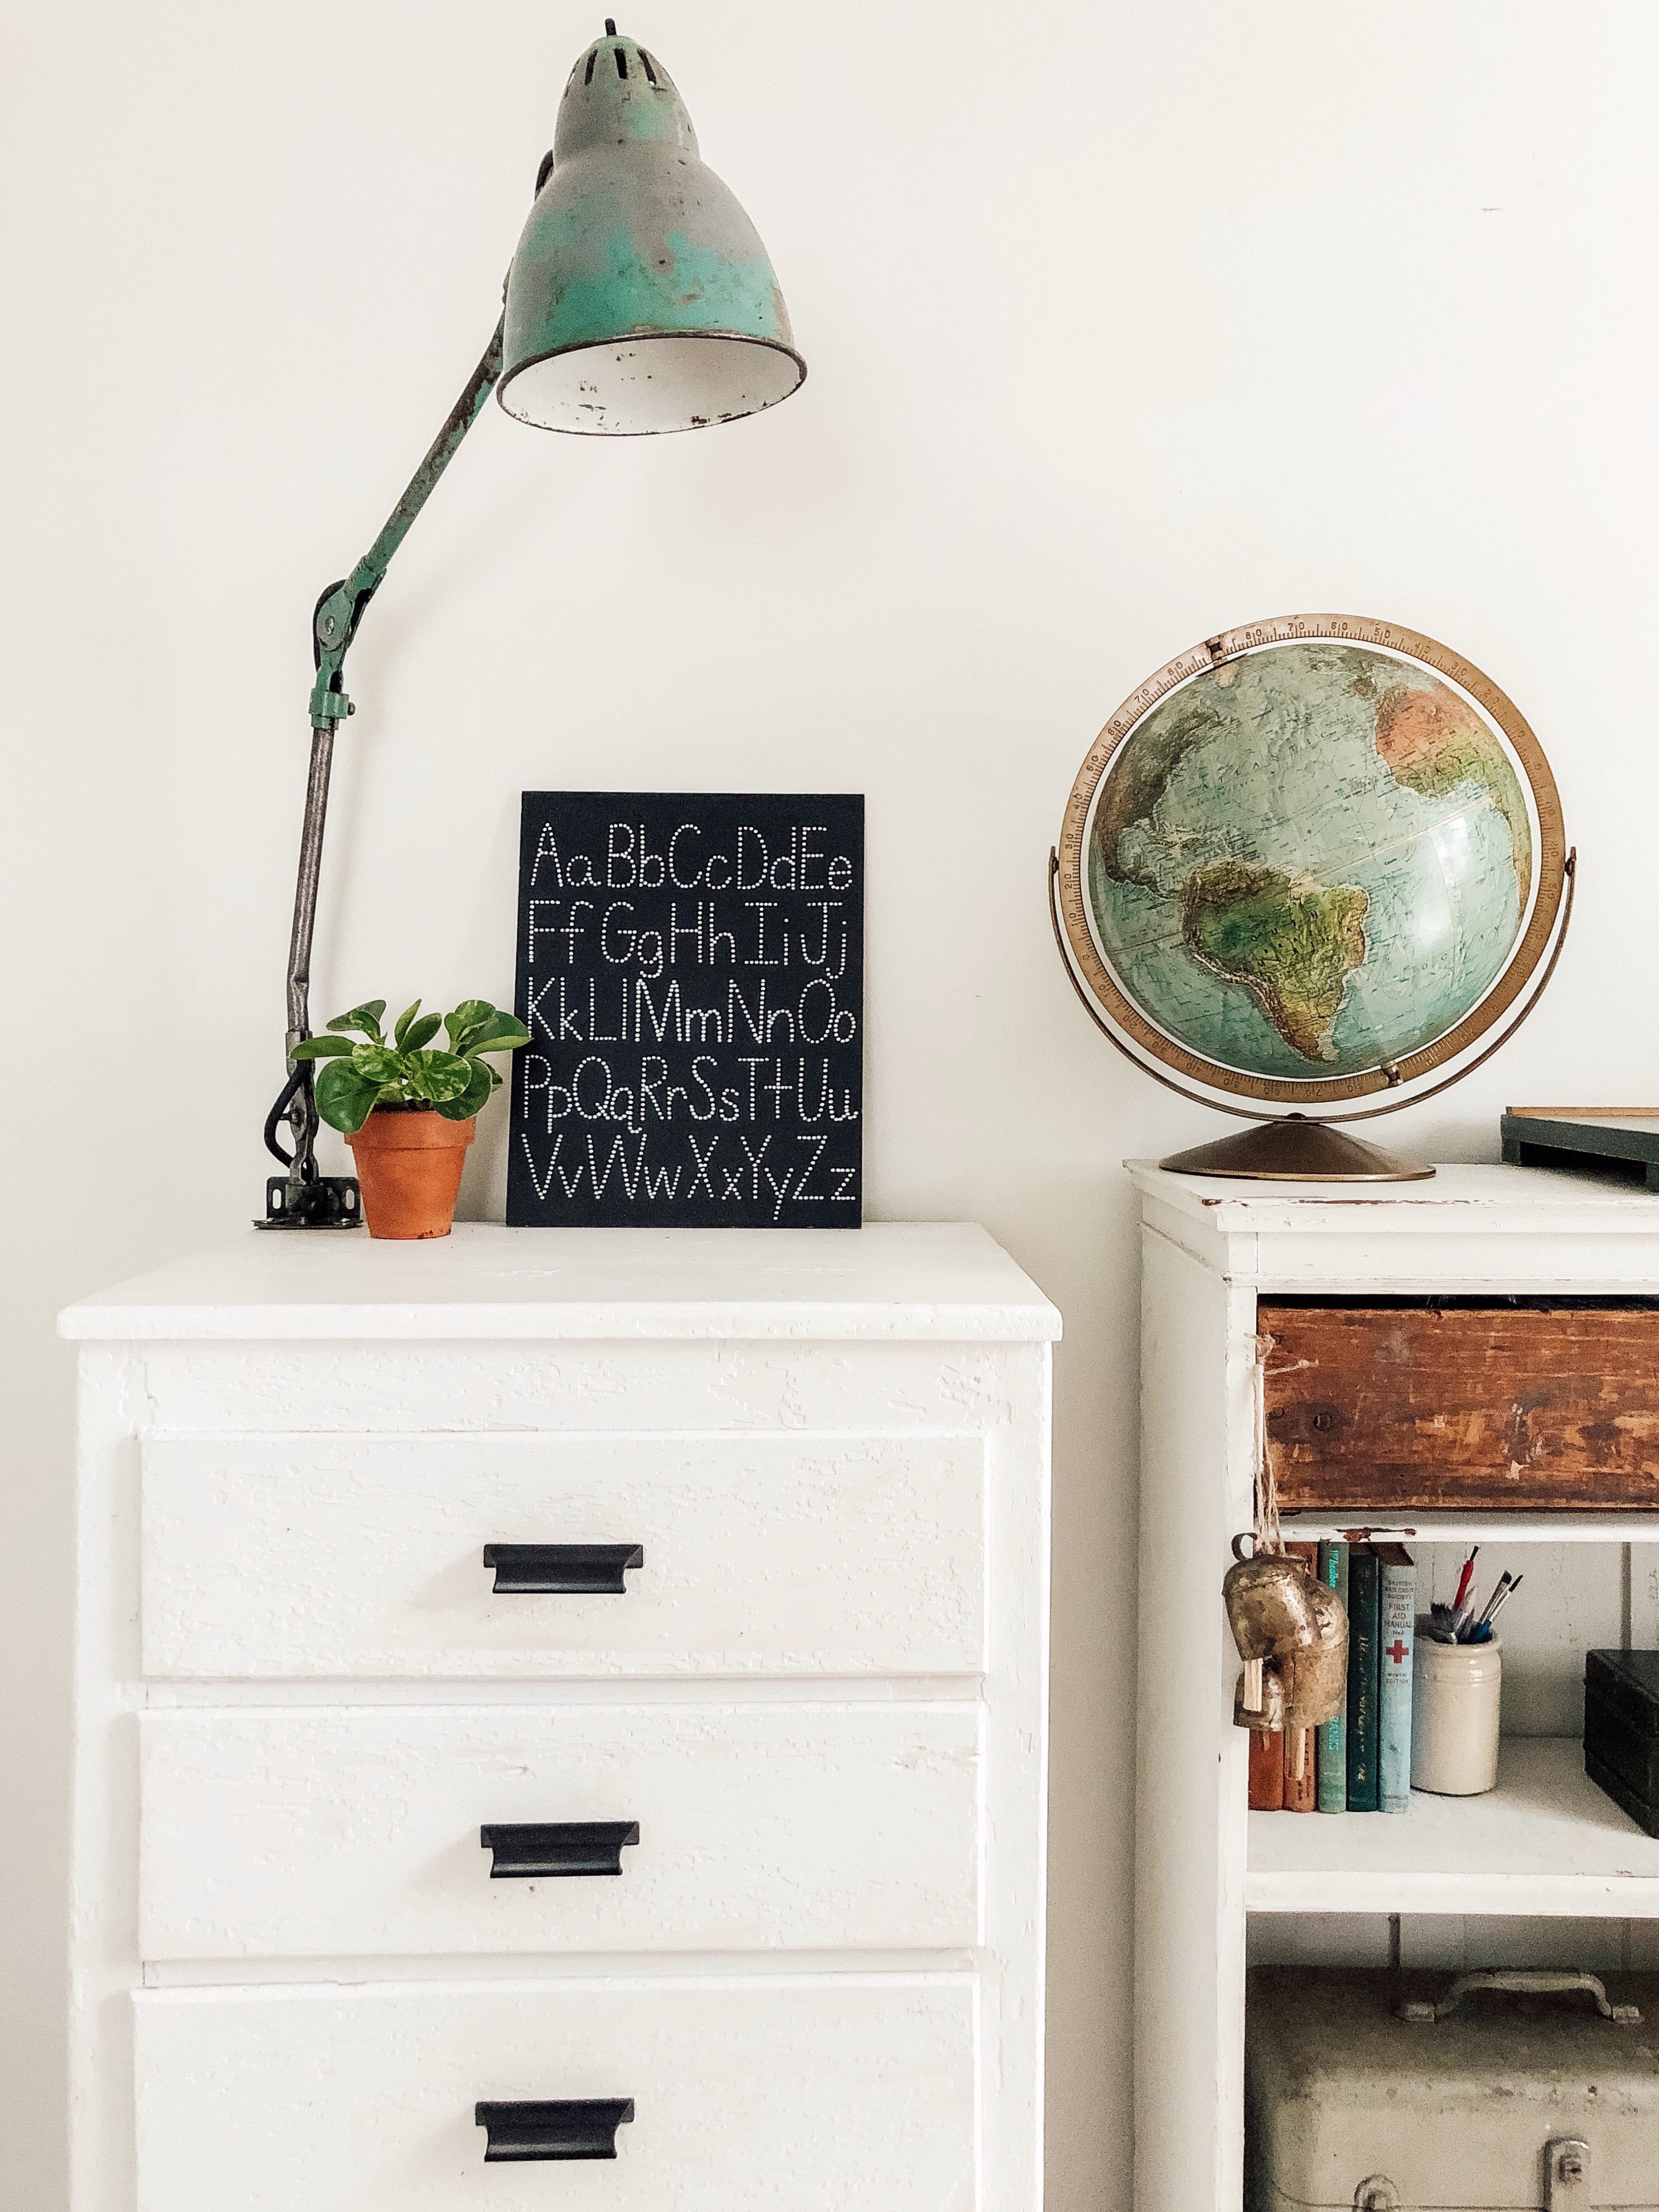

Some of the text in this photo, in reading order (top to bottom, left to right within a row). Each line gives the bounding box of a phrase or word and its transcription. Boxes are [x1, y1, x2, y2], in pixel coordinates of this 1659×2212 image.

[1287, 622, 1304, 631] 70
[1330, 620, 1348, 631] 60
[1244, 628, 1262, 640] 80
[1373, 627, 1391, 639] 50
[1167, 662, 1183, 675] 80
[1134, 688, 1149, 703] 70
[1064, 833, 1074, 849] 30
[1063, 873, 1073, 889] 20
[1069, 913, 1078, 926] 10
[1122, 1014, 1137, 1029] 20
[1389, 1602, 1410, 1611] FIRST
[1384, 1620, 1412, 1628] MANUAL
